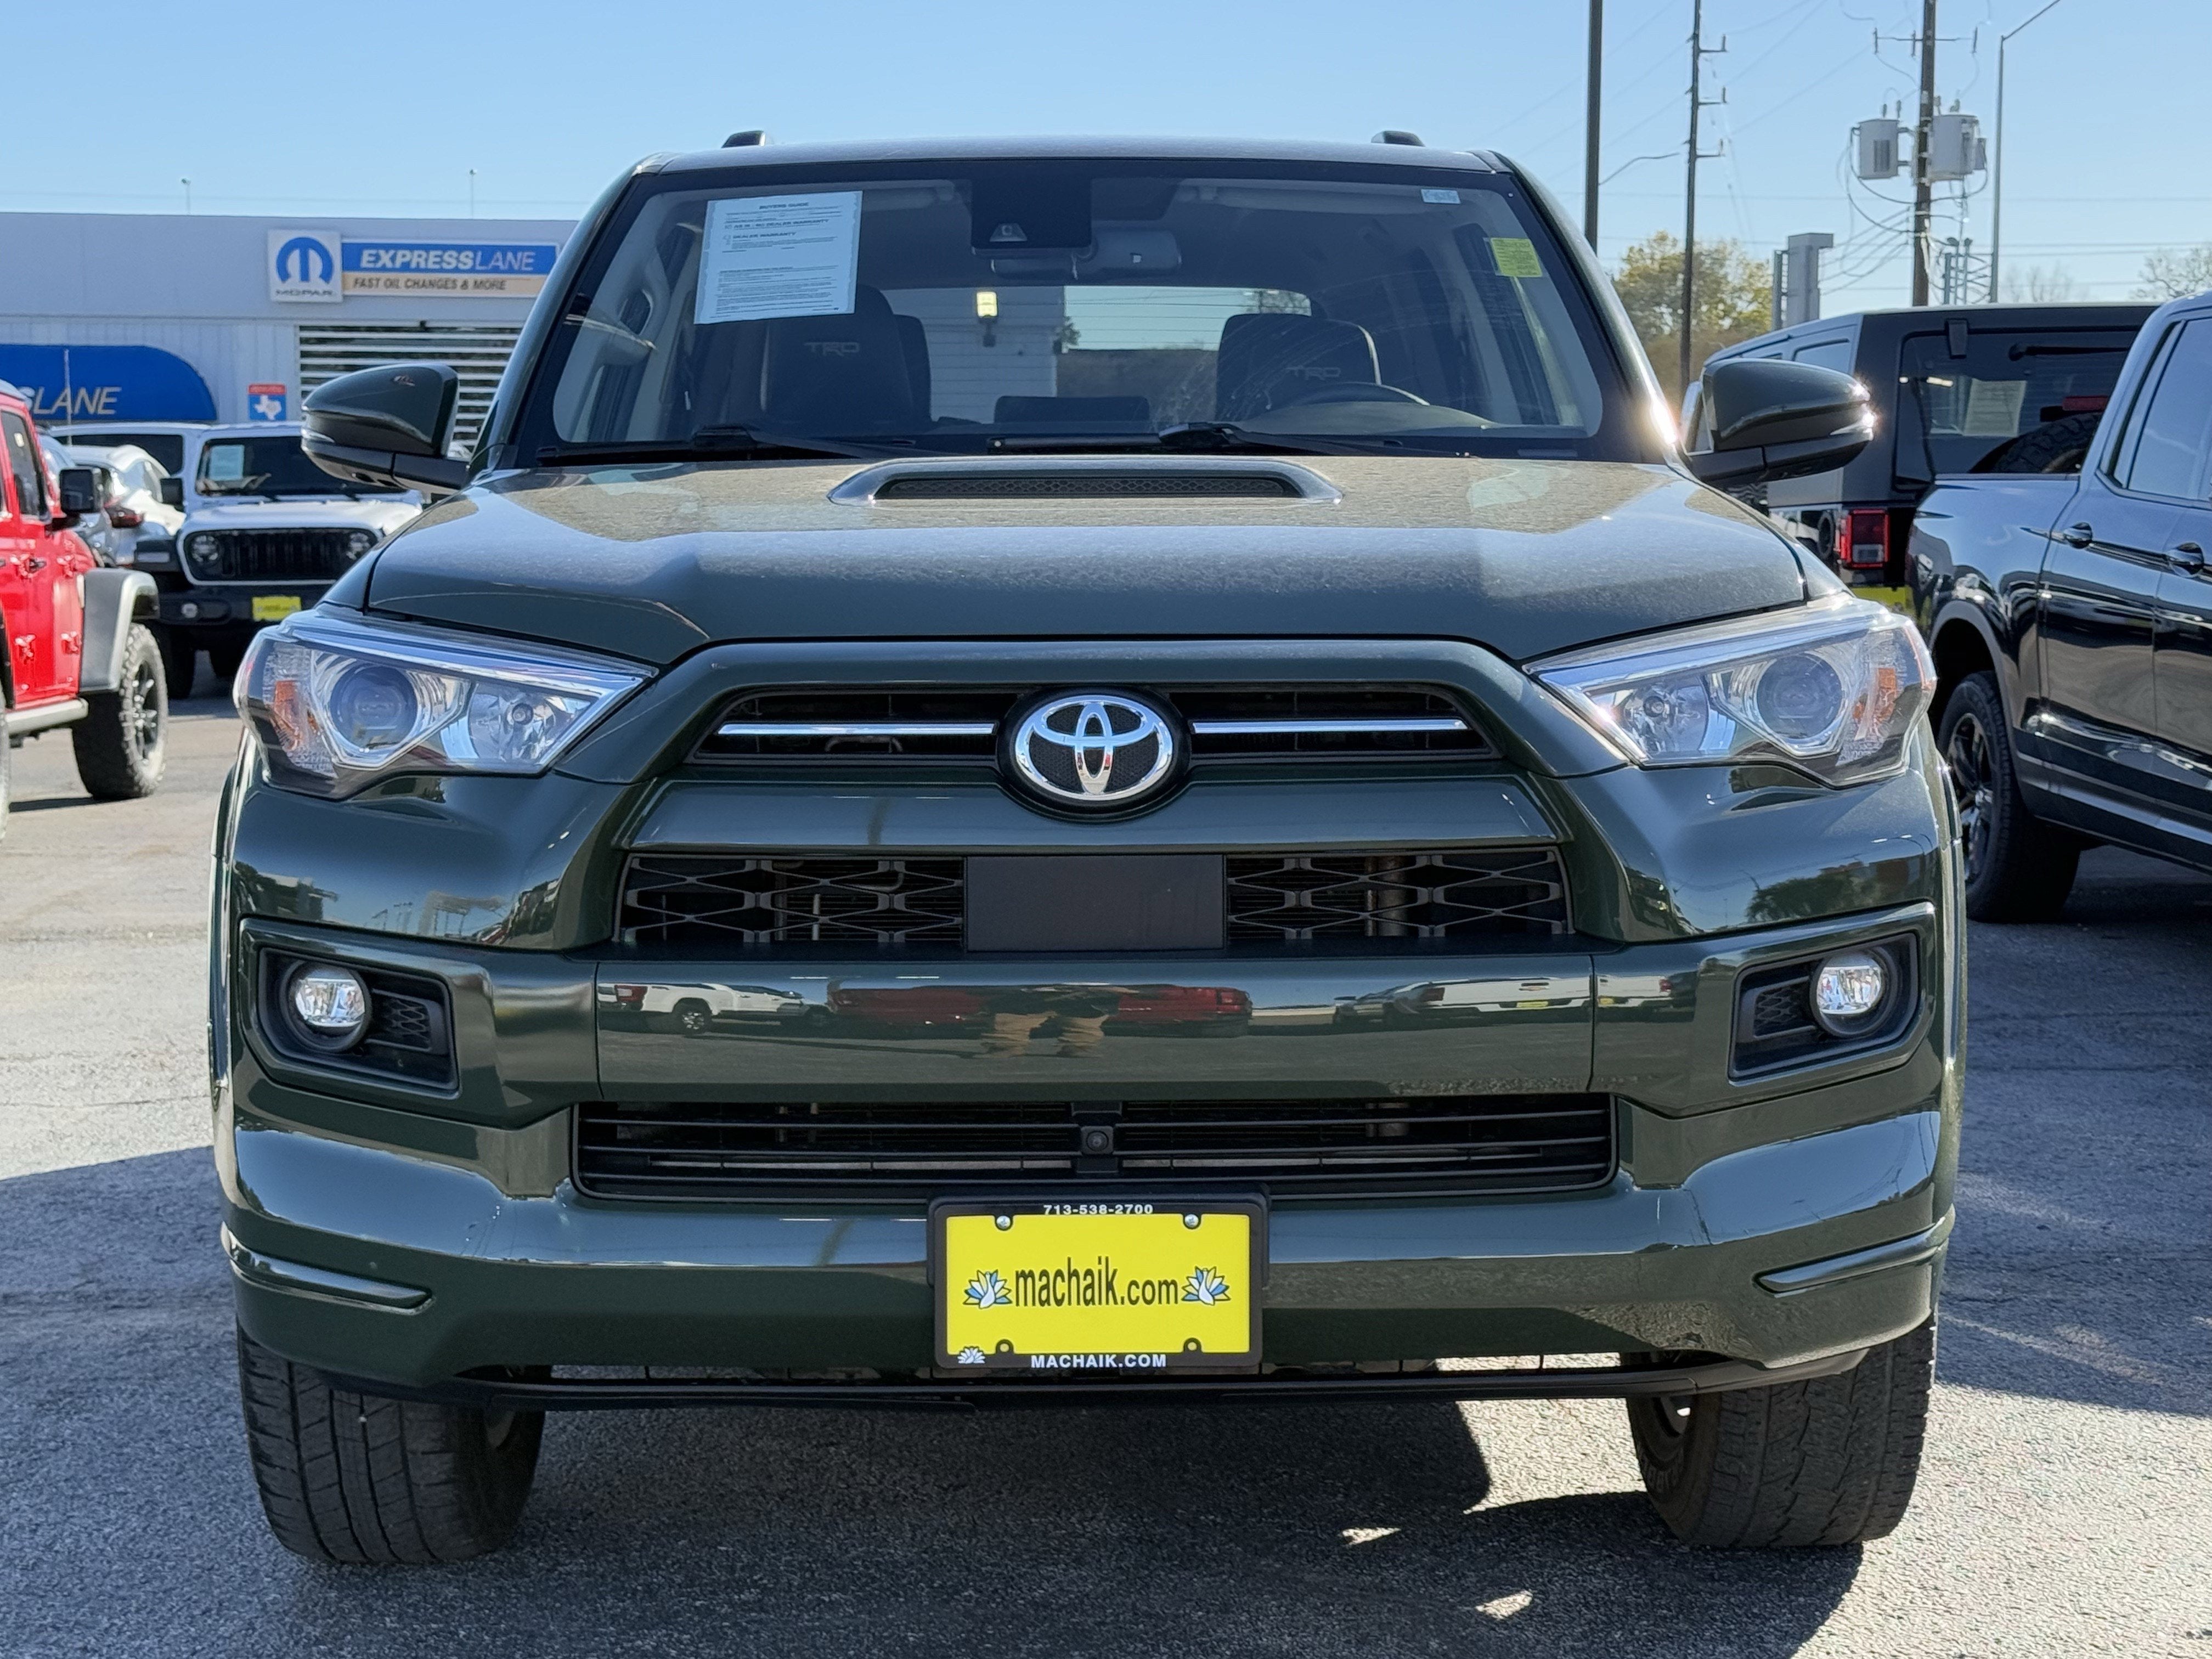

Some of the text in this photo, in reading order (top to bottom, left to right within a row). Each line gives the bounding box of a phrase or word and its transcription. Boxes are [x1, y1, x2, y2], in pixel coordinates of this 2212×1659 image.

[360, 249, 536, 271] EXPRESSLANE
[354, 278, 506, 290] FAST OIL CHANGES & MORE
[804, 342, 860, 357] TRD
[1043, 1204, 1153, 1215] 713-538-2700
[1015, 1256, 1178, 1307] machaik.com
[1031, 1355, 1166, 1368] MACHAIK.COM
